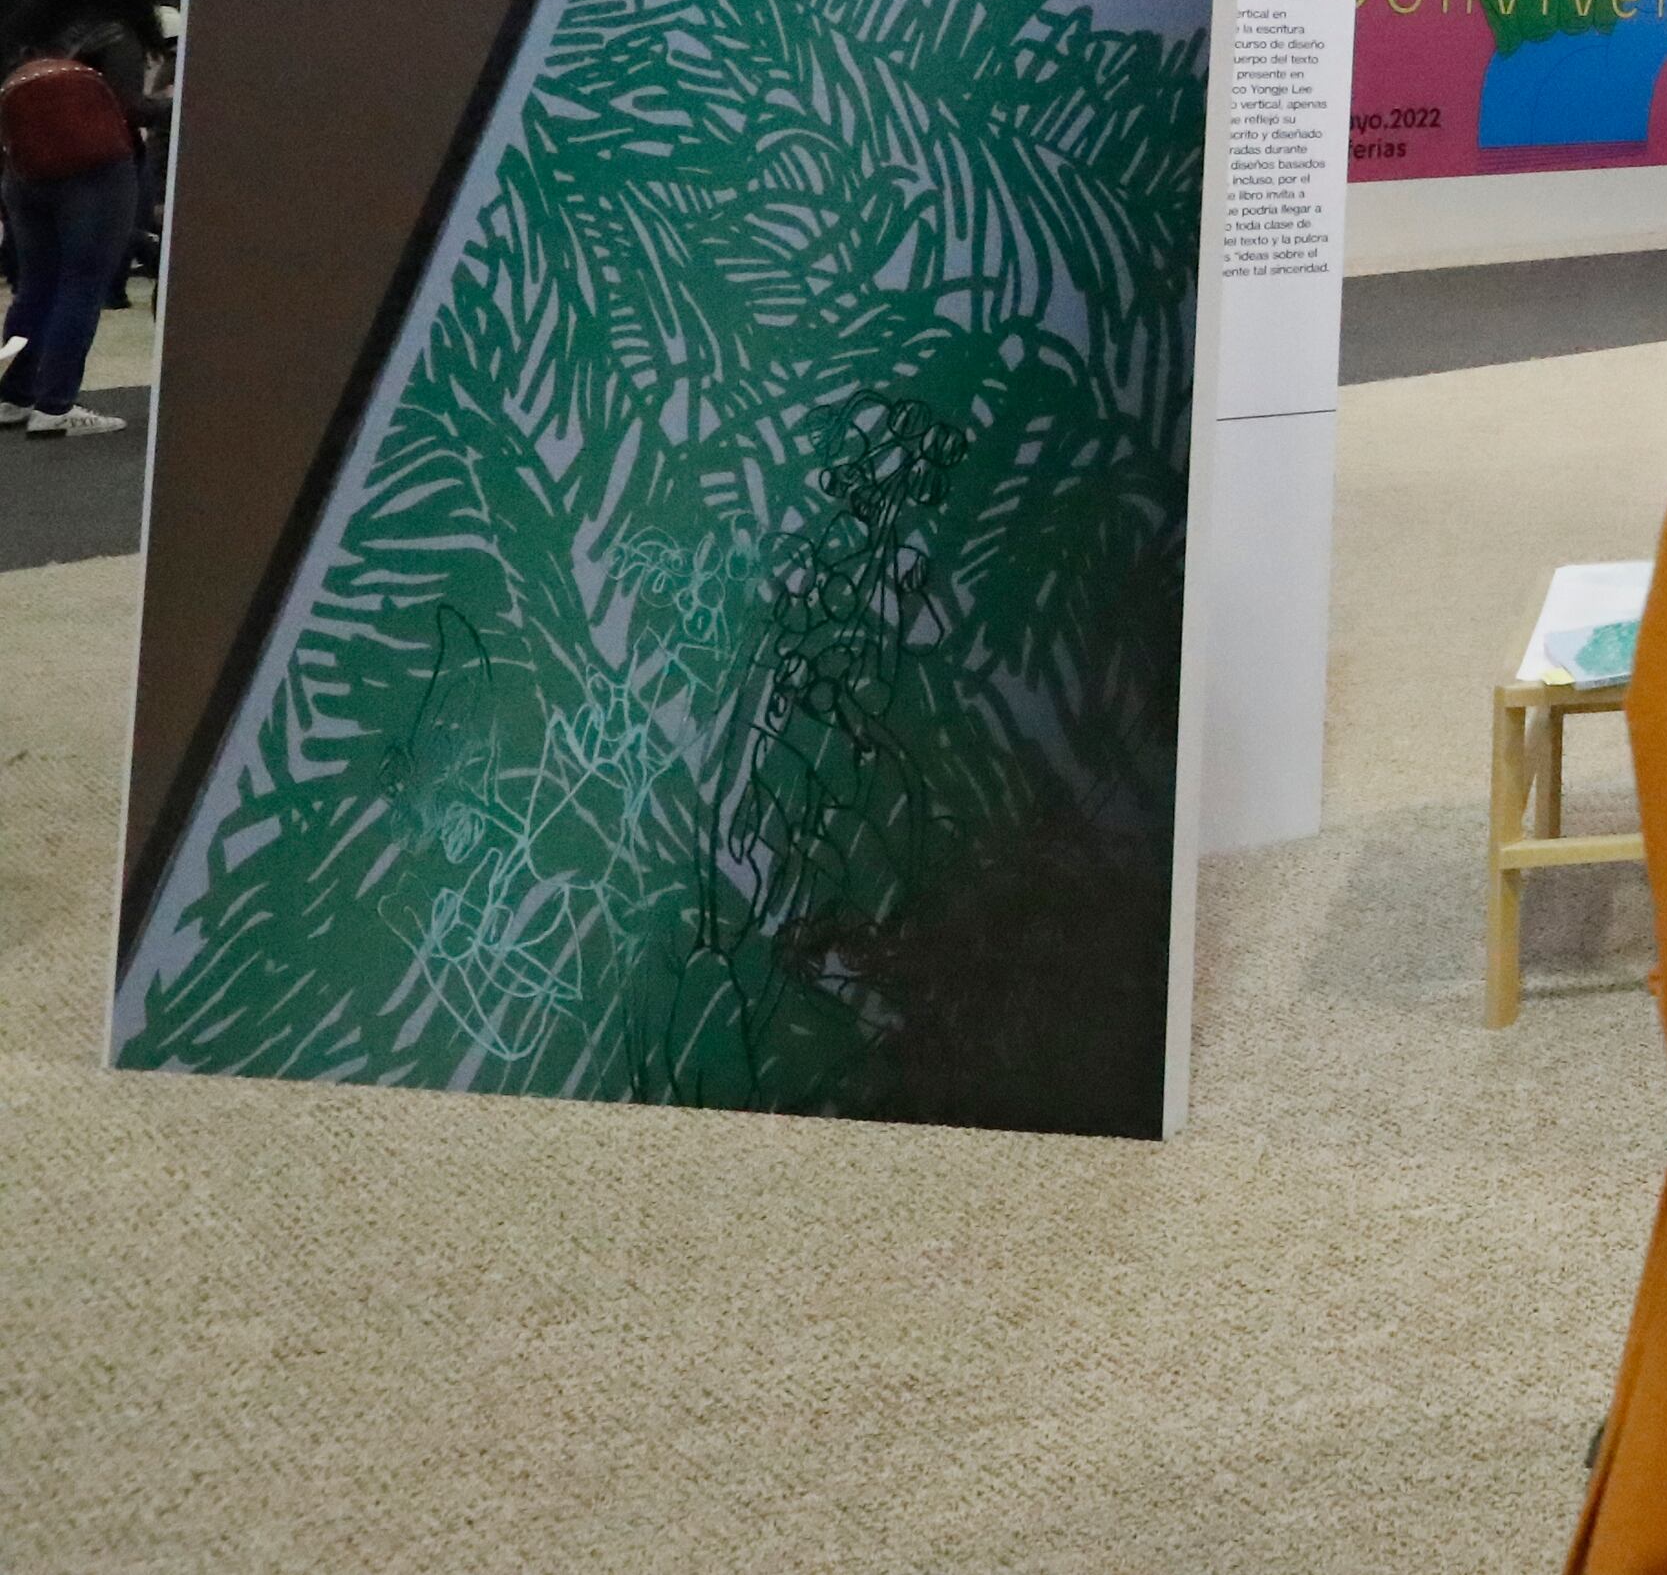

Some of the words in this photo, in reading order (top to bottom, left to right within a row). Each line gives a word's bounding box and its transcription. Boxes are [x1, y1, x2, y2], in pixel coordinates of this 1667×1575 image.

[1256, 24, 1305, 34] escritura
[1269, 40, 1285, 49] de
[1270, 54, 1288, 64] del
[1291, 54, 1319, 64] texto
[1237, 70, 1287, 80] presente
[1290, 71, 1304, 79] en
[1286, 100, 1328, 111] apenas
[1264, 144, 1308, 155] durante
[1278, 159, 1326, 170] basados
